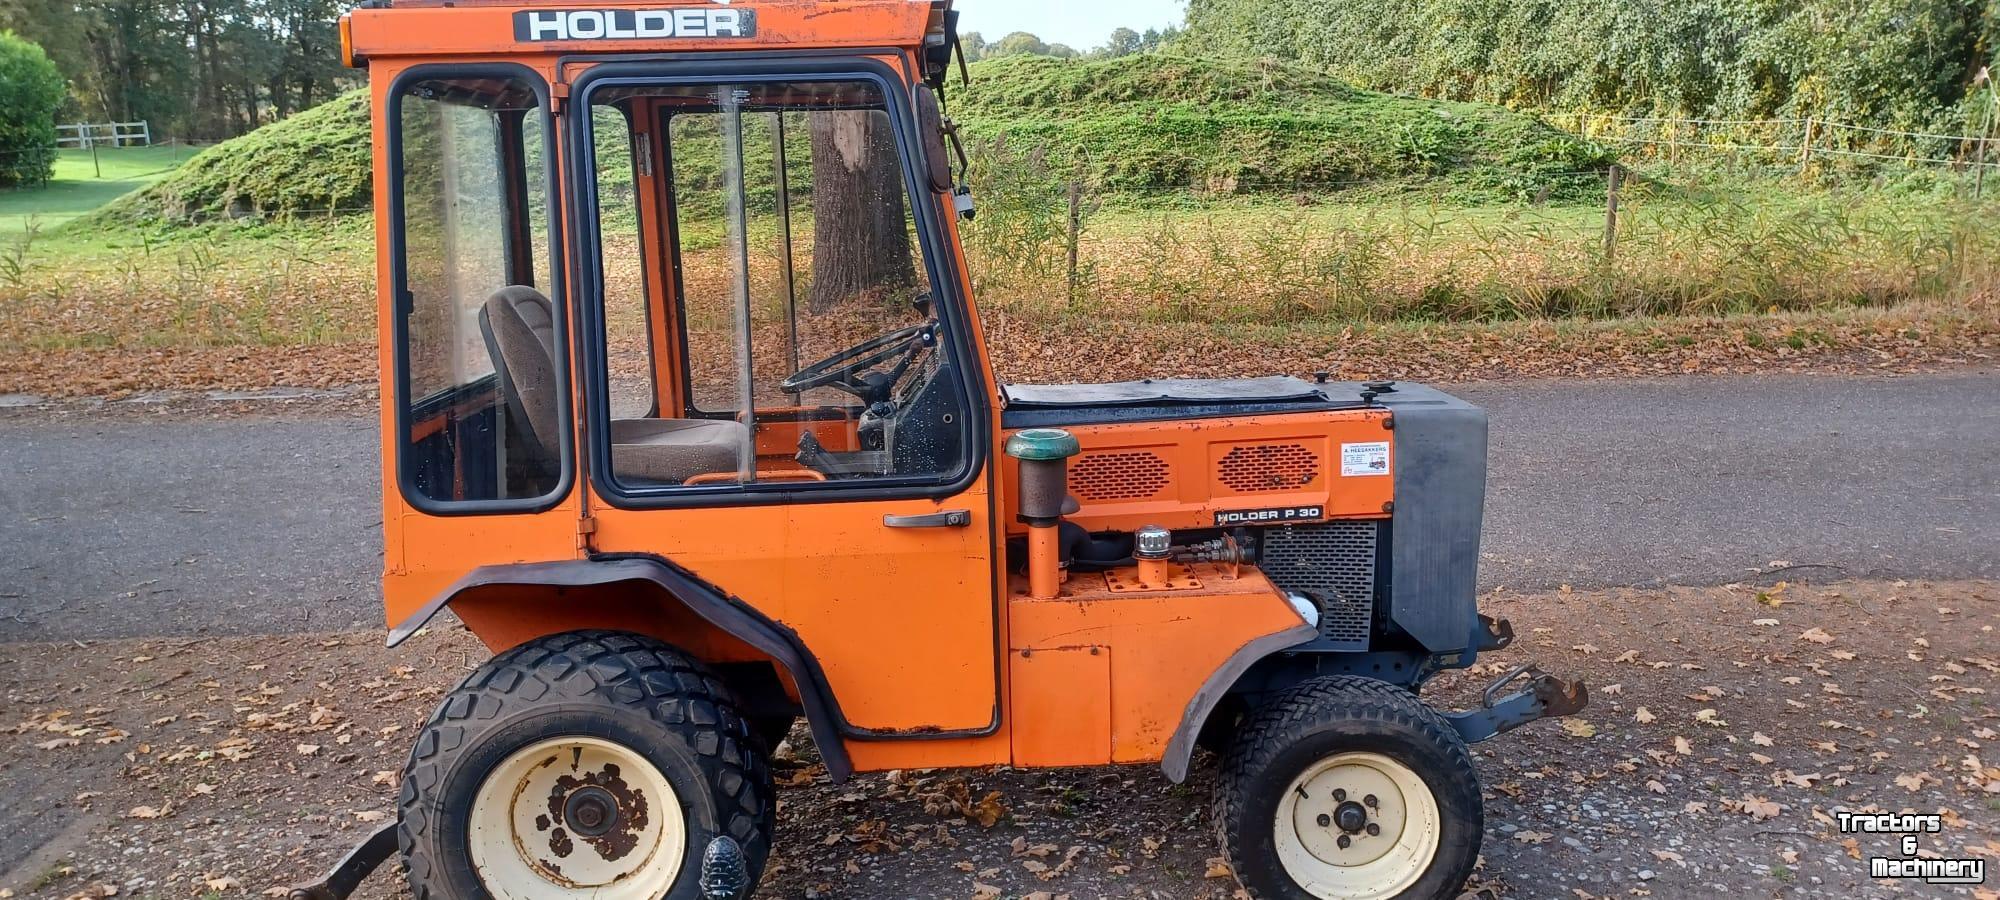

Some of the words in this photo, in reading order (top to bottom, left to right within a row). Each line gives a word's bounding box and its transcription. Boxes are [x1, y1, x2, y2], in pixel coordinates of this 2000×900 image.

[528, 8, 741, 41] HOLDER
[1217, 510, 1279, 522] HOLDER
[1285, 509, 1295, 518] P
[1299, 508, 1319, 517] 30
